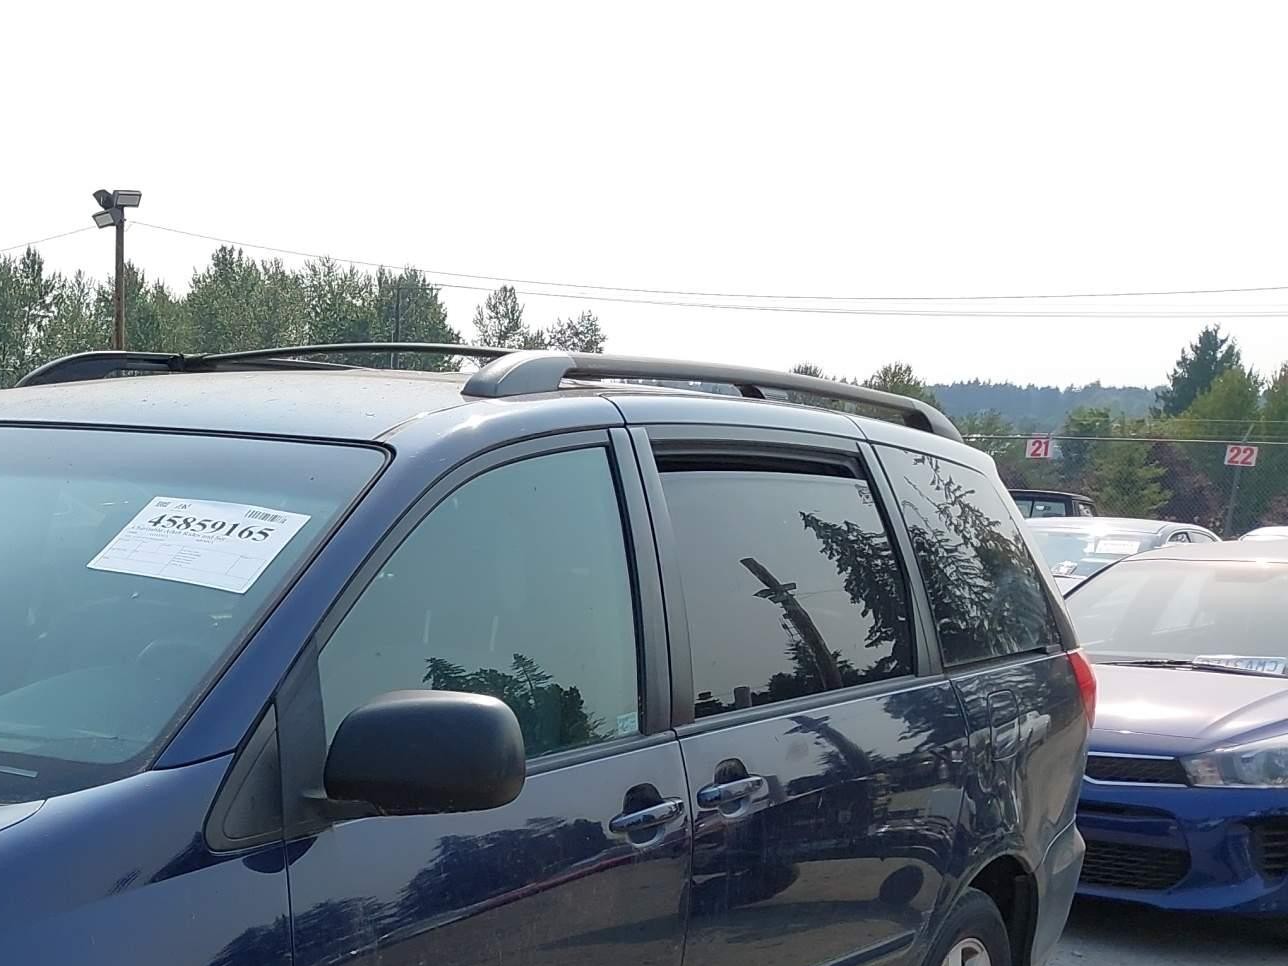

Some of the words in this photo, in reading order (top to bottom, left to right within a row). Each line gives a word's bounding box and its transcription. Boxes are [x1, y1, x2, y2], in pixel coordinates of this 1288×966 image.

[1031, 440, 1050, 457] 21
[1227, 446, 1255, 465] 22
[148, 513, 276, 542] 45859165
